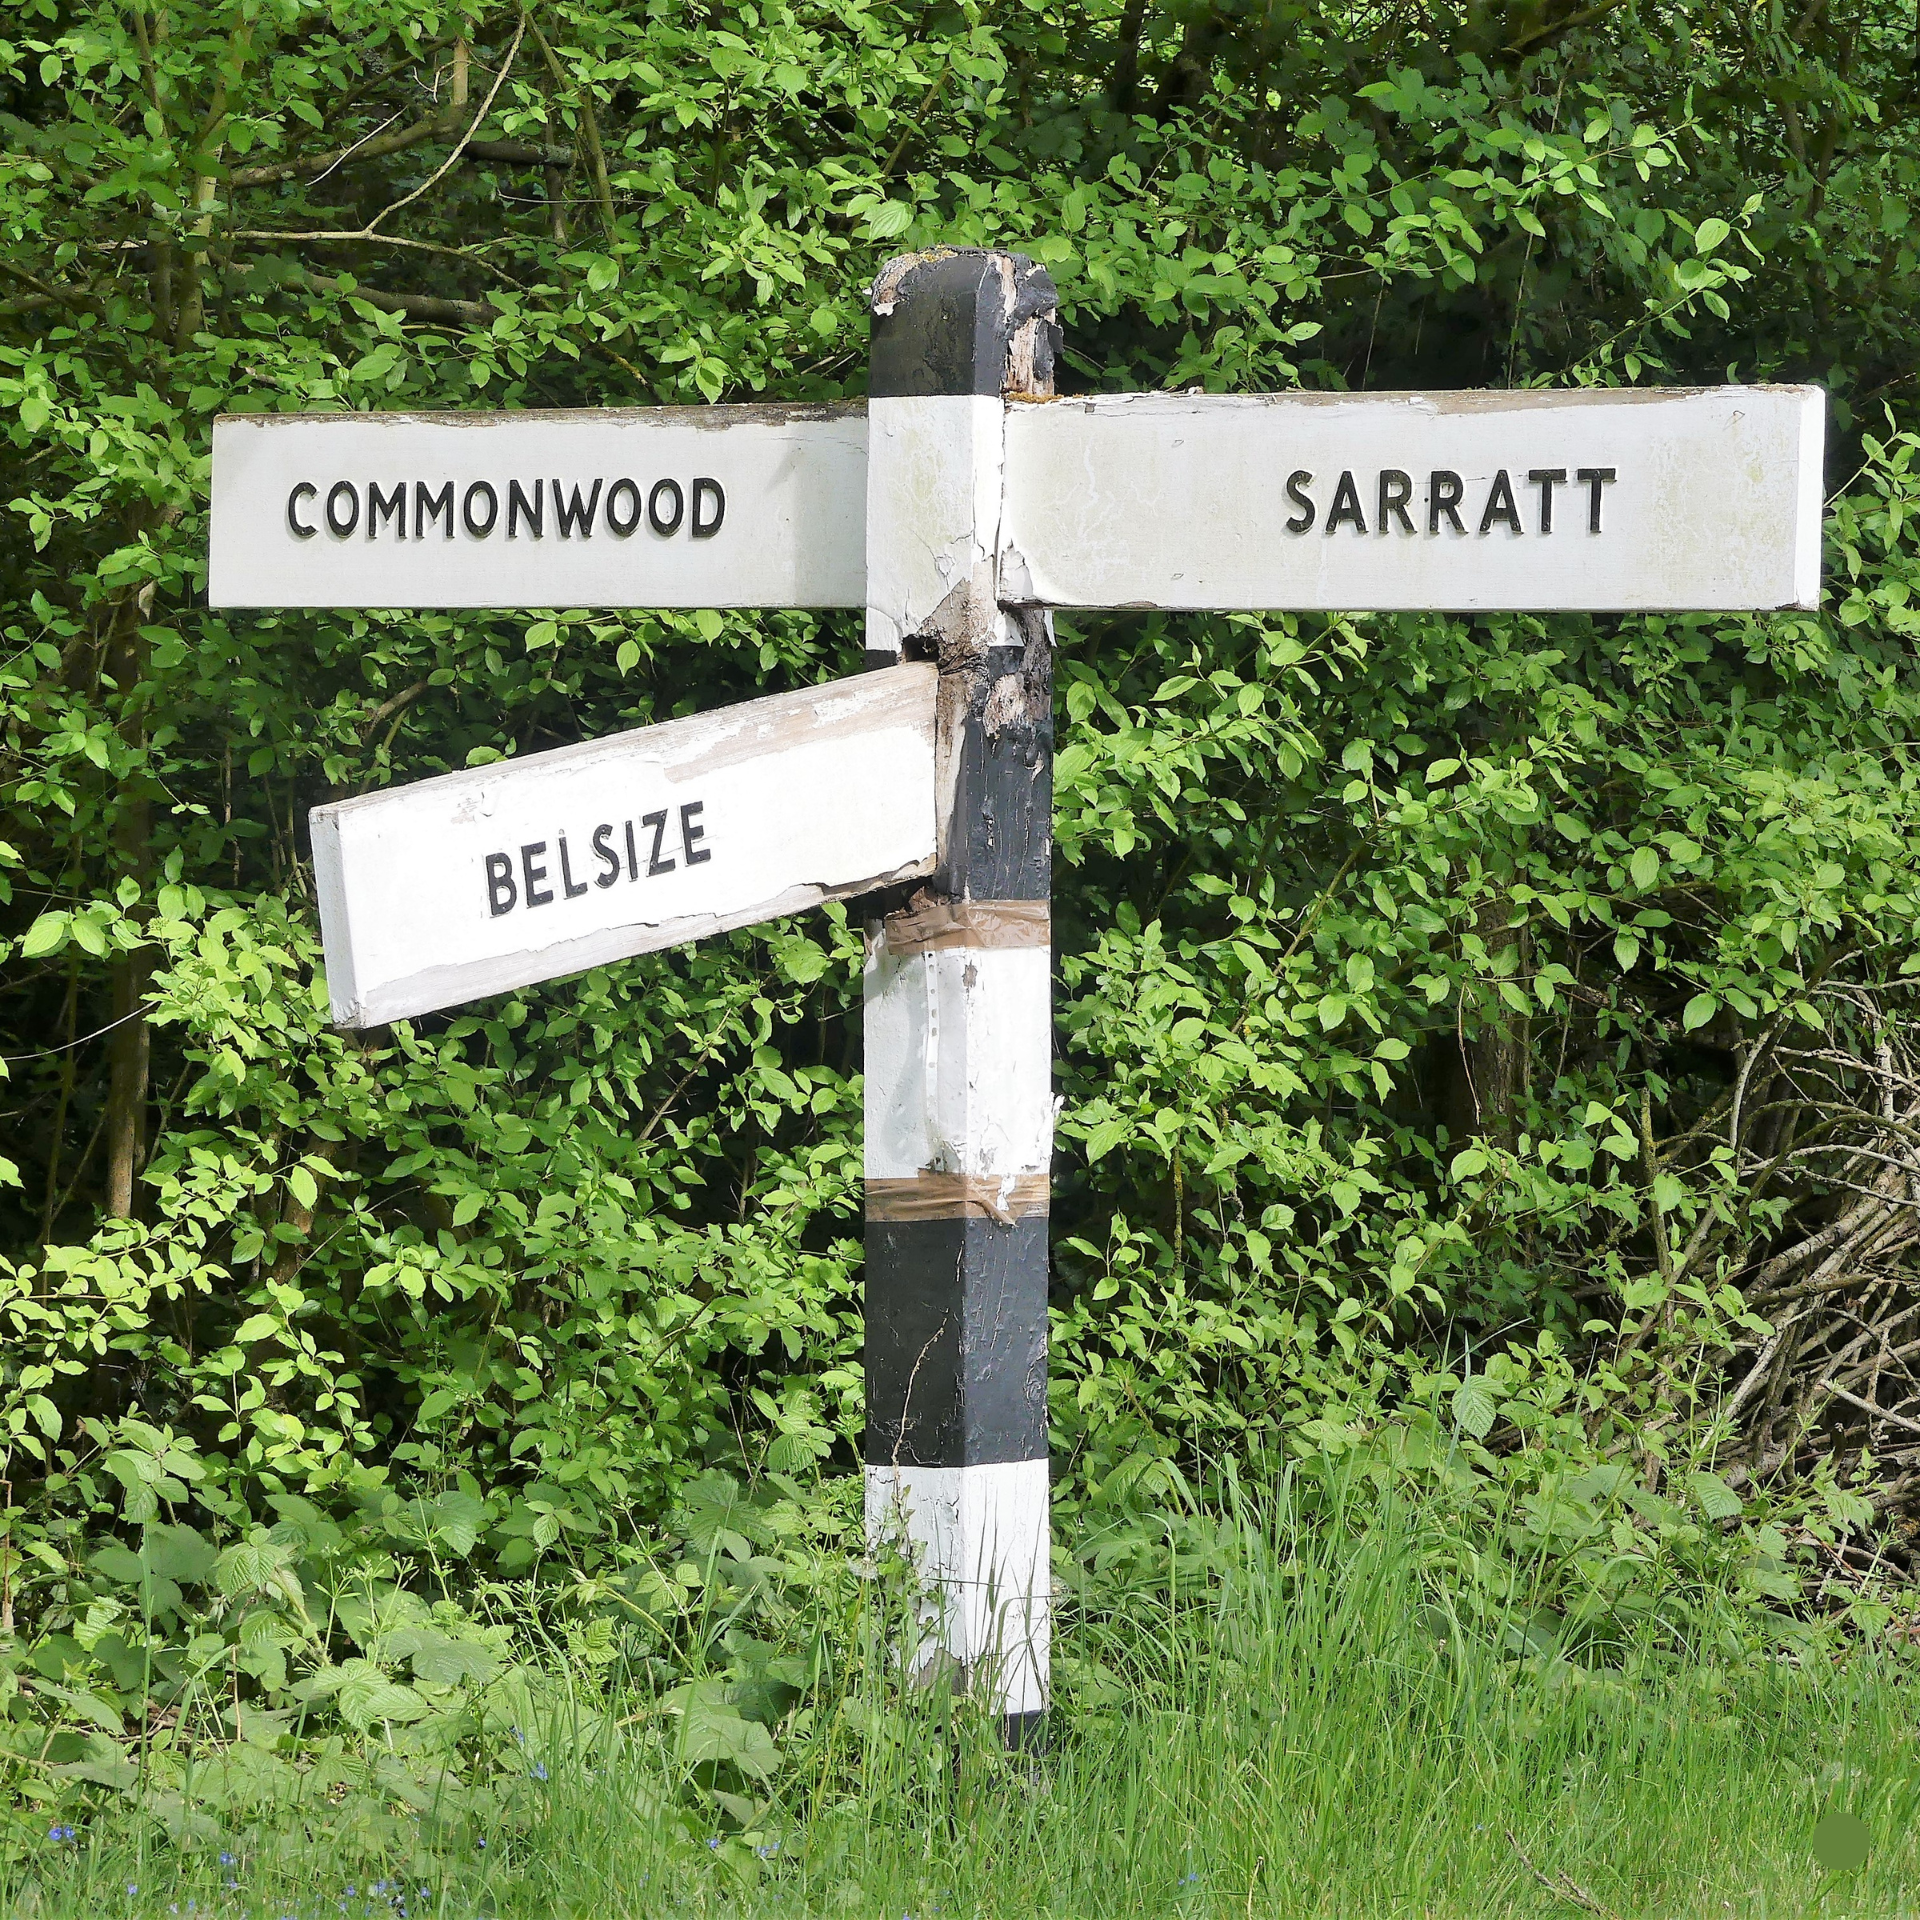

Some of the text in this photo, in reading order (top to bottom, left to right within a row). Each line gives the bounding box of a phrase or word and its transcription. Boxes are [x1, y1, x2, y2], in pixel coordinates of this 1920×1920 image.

[287, 477, 726, 540] COMMONWOOD
[1285, 467, 1618, 535] SARRATT
[485, 800, 712, 917] BELSIZE
